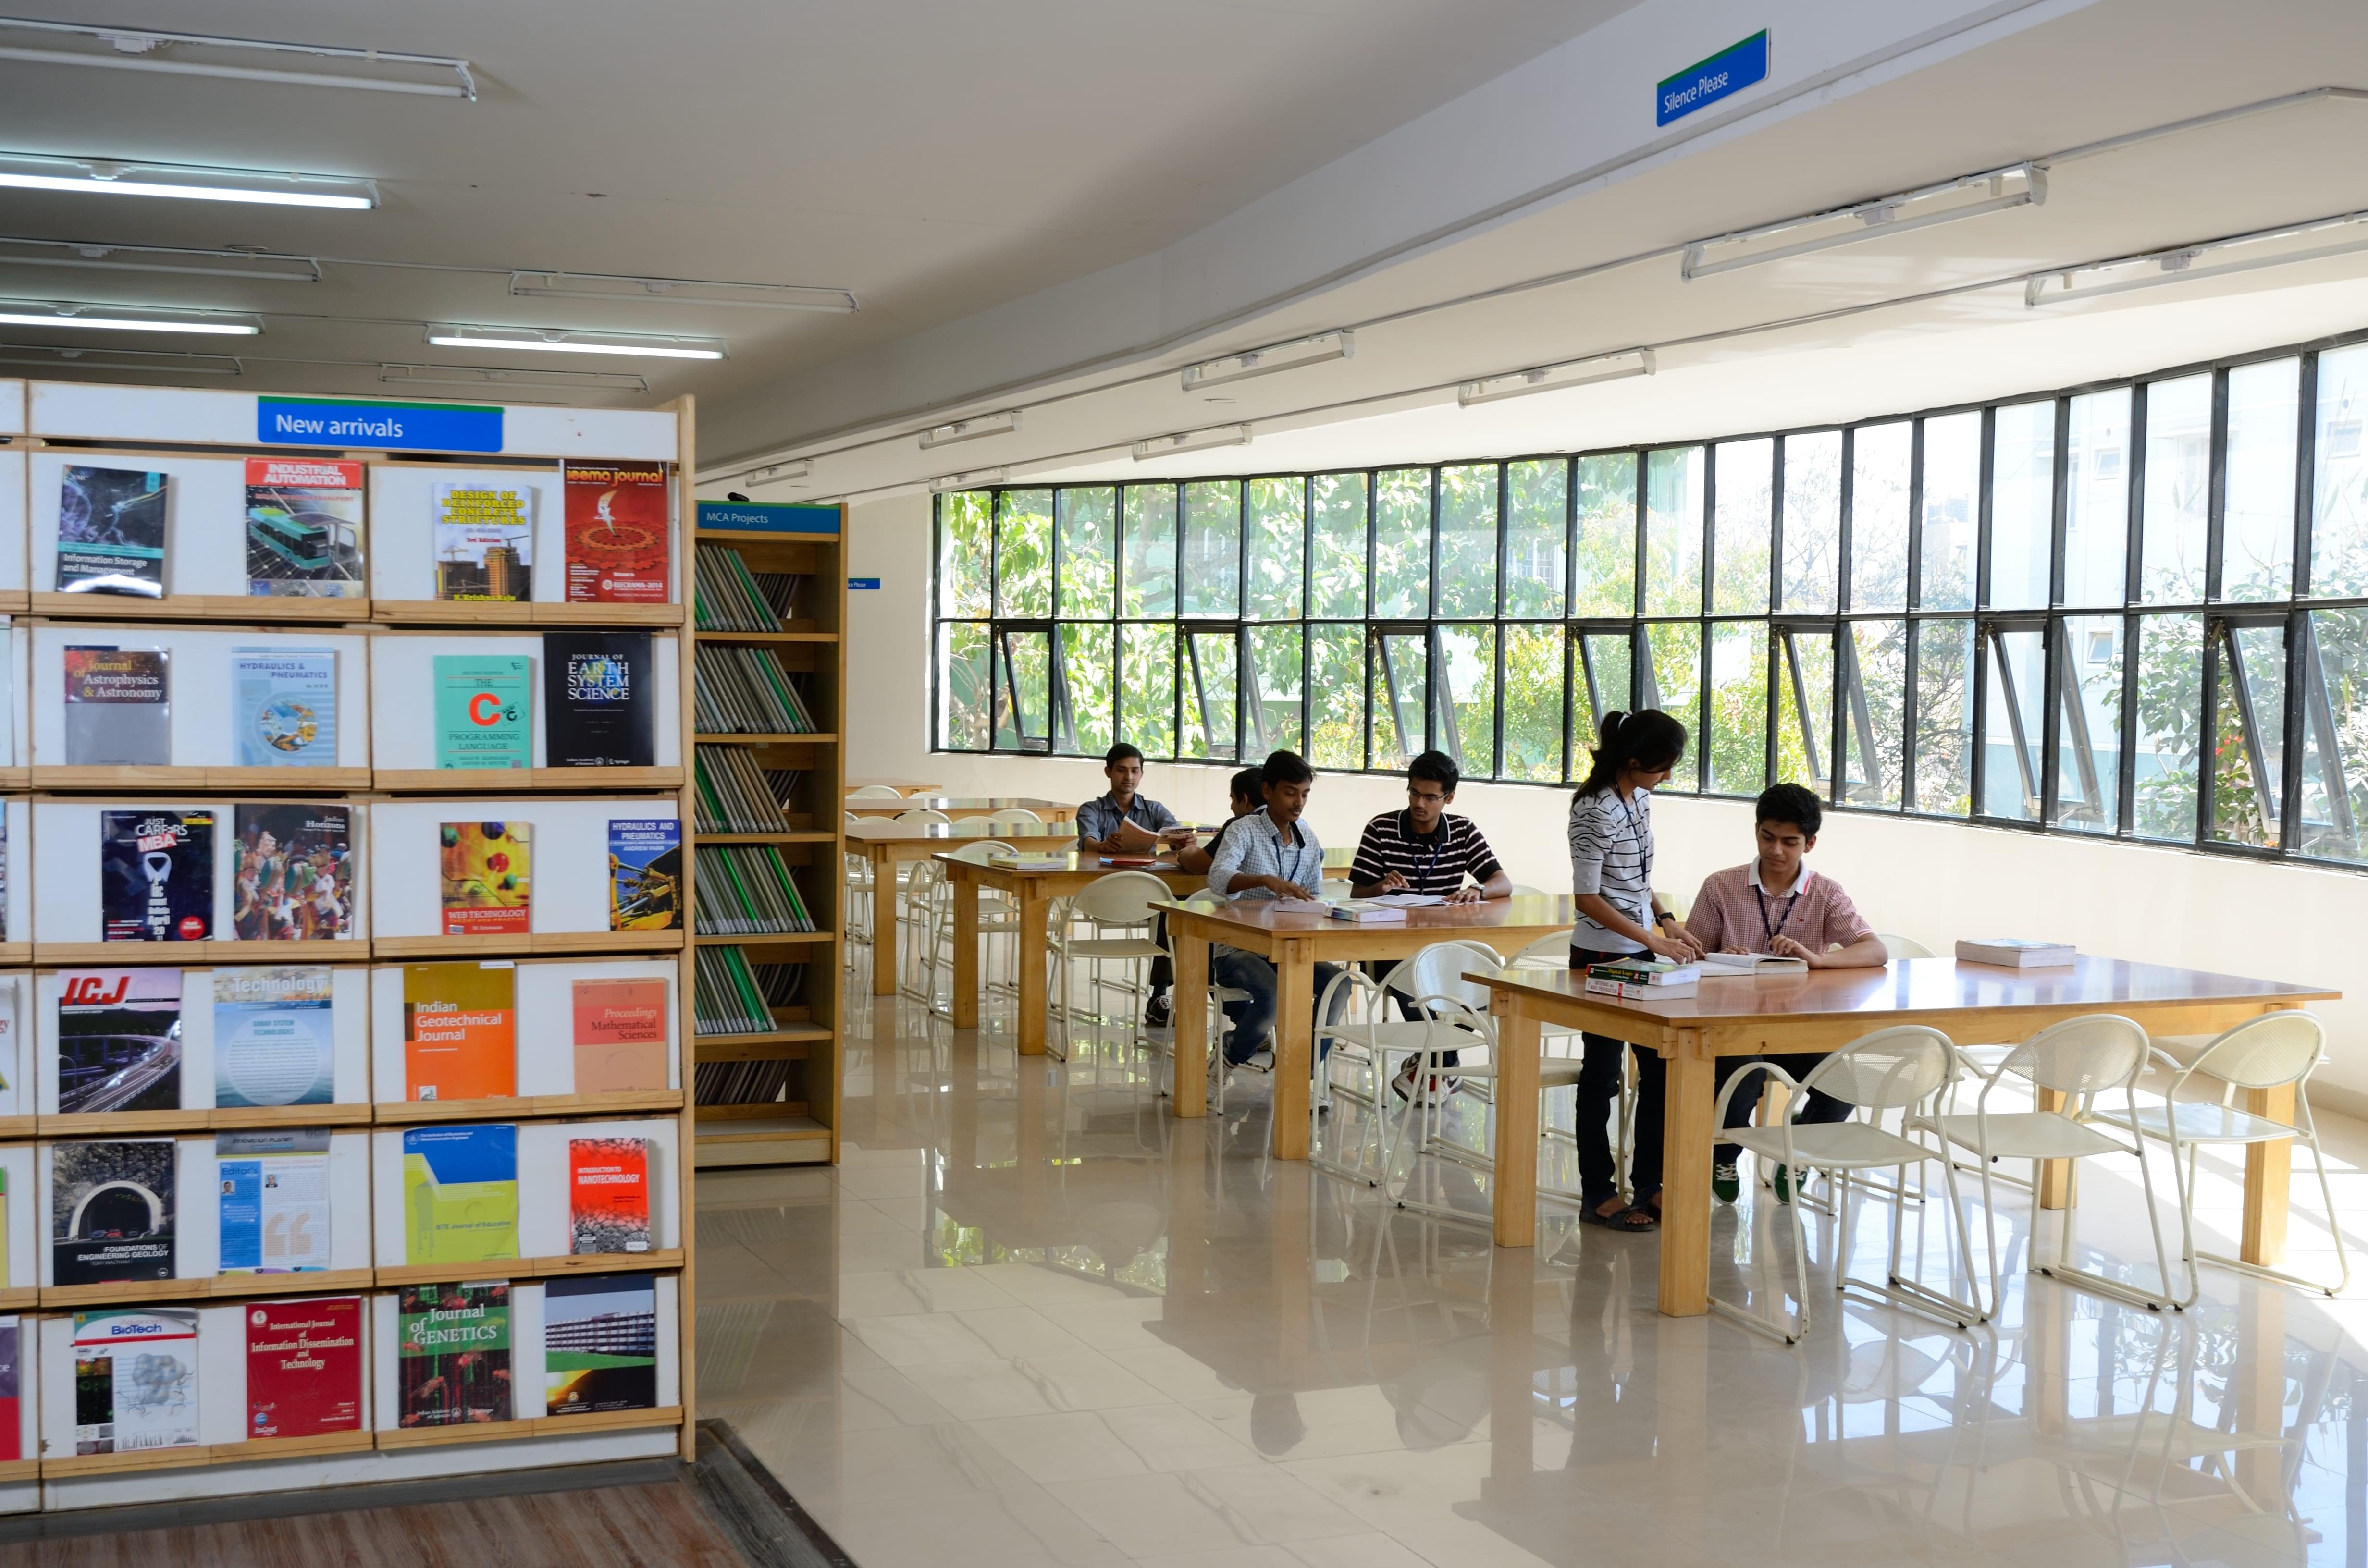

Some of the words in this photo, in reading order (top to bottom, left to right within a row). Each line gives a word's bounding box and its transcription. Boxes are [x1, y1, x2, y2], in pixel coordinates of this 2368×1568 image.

[1664, 86, 1697, 114] Silence
[1699, 72, 1728, 97] Please
[276, 414, 324, 434] New
[329, 418, 404, 438] arrivals
[268, 463, 343, 475] INDUSTRIAL
[264, 474, 346, 485] AUTOMATION
[611, 469, 663, 487] journal
[450, 490, 496, 499] DESIGN
[500, 491, 517, 500] OF
[442, 499, 525, 508] REINFORCED
[451, 507, 517, 516] CONCRETE
[442, 515, 526, 525] STRUCTURES
[707, 512, 729, 522] MCA
[731, 513, 768, 525] Projects
[64, 554, 113, 564] Information
[115, 557, 148, 568] Storage
[81, 564, 135, 576] Management
[88, 660, 132, 671] Journal
[567, 662, 629, 674] EARTH
[74, 669, 86, 678] of
[84, 674, 159, 687] Astrophysics
[567, 675, 629, 687] SYSTEM
[84, 687, 94, 697] &
[97, 687, 162, 700] Astronomy
[567, 688, 630, 700] SCIENCE
[468, 692, 502, 727] C
[306, 820, 345, 829] Horizons
[137, 833, 177, 852] MBA
[469, 909, 526, 918] TECHNOLOGY
[148, 915, 170, 927] April
[62, 976, 131, 1006] ICJ
[233, 976, 324, 994] Technology
[417, 1001, 457, 1013] Indian
[604, 1007, 658, 1019] Proceedings
[416, 1013, 502, 1027] Geotechnical
[591, 1019, 656, 1030] Mathematical
[417, 1028, 465, 1041] Journal
[618, 1030, 657, 1040] Sciences
[222, 1167, 258, 1175] Editor's
[578, 1174, 640, 1185] NANOTECHNOLOGY
[103, 1244, 158, 1253] FOUNDATIONS
[77, 1252, 130, 1261] ENGINEERING
[131, 1250, 169, 1258] GEOLOGY
[430, 1303, 485, 1324] Journal
[270, 1320, 311, 1330] International
[312, 1319, 335, 1329] Journal
[410, 1317, 428, 1333] of
[414, 1325, 497, 1345] GENETICS
[251, 1340, 298, 1352] Information
[299, 1336, 354, 1348] Dissemination
[281, 1358, 326, 1370] Technology
